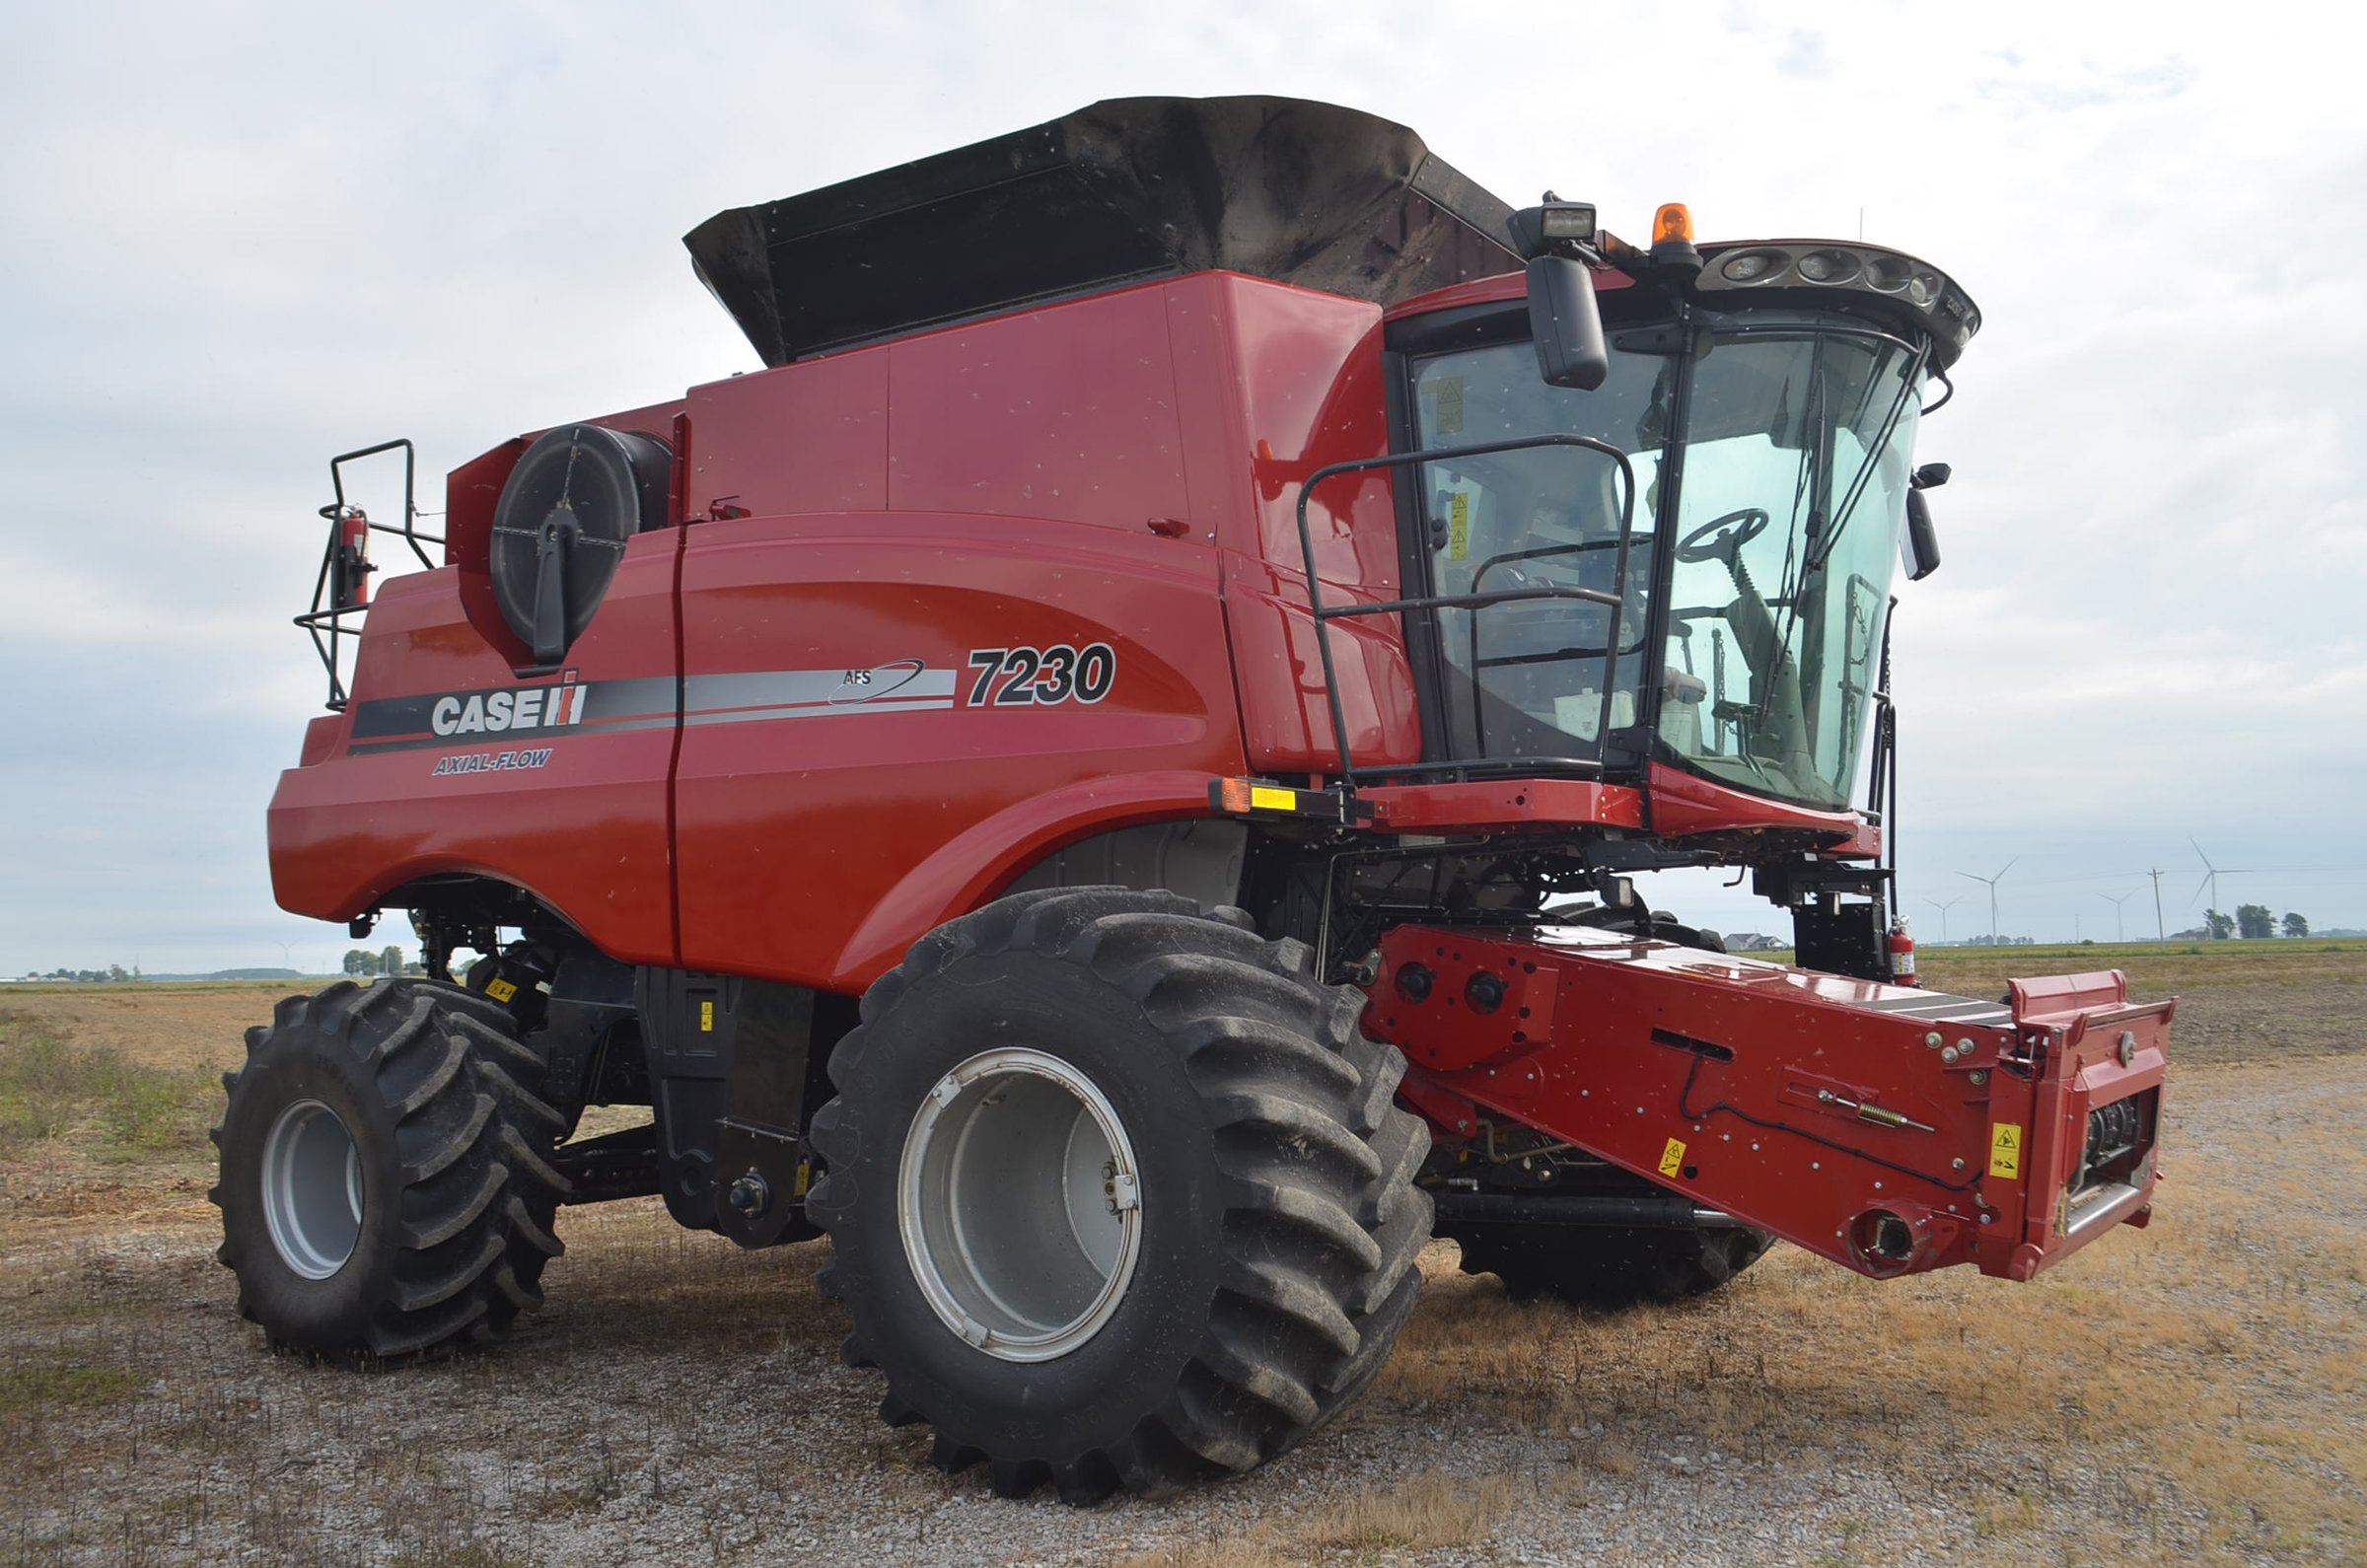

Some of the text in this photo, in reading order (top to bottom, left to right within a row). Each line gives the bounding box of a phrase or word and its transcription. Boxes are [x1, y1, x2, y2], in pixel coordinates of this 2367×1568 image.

[842, 670, 871, 685] AFS
[967, 642, 1116, 707] 7230
[432, 689, 543, 736] CASE
[431, 748, 553, 776] AXIAL-FLOW
